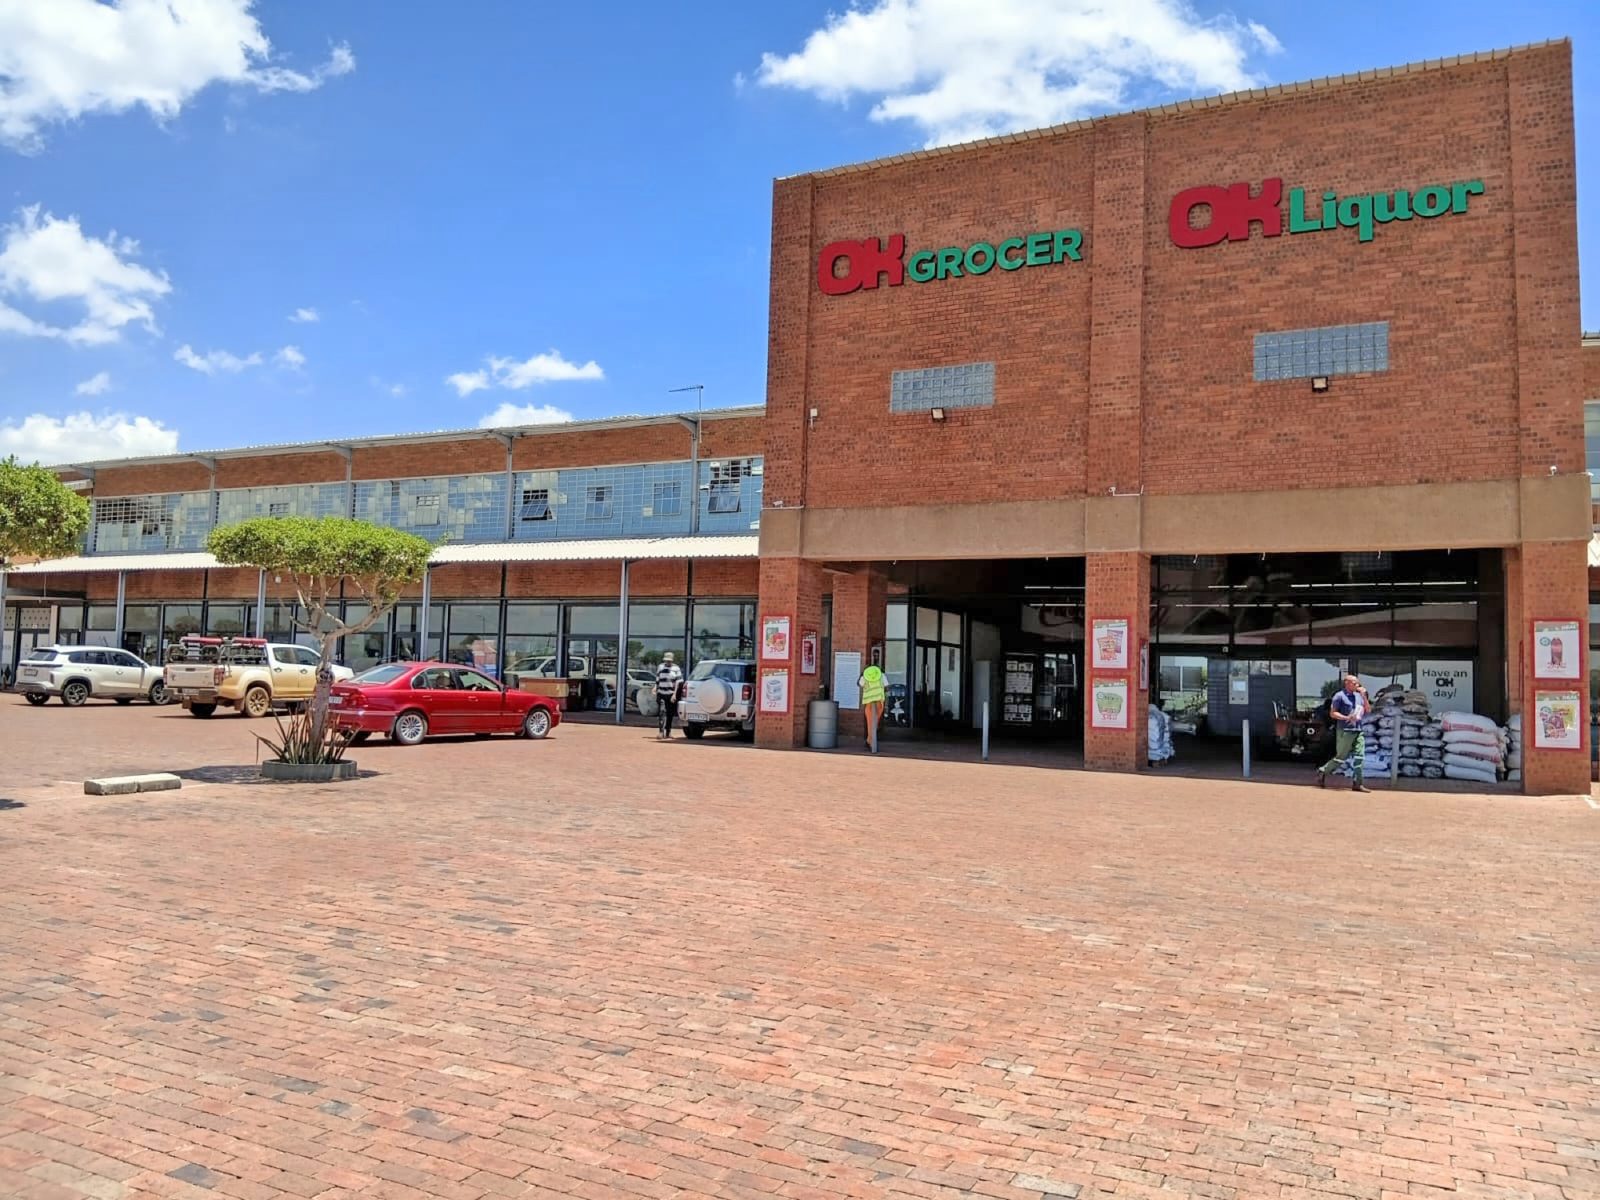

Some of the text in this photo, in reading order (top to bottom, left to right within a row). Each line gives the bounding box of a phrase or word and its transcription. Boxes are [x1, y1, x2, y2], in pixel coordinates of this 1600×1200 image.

[1169, 177, 1484, 248] OK Liquor
[818, 230, 1083, 296] OK GROCER
[1422, 669, 1468, 678] Have an
[1435, 677, 1454, 687] OK
[1432, 688, 1457, 699] day!
